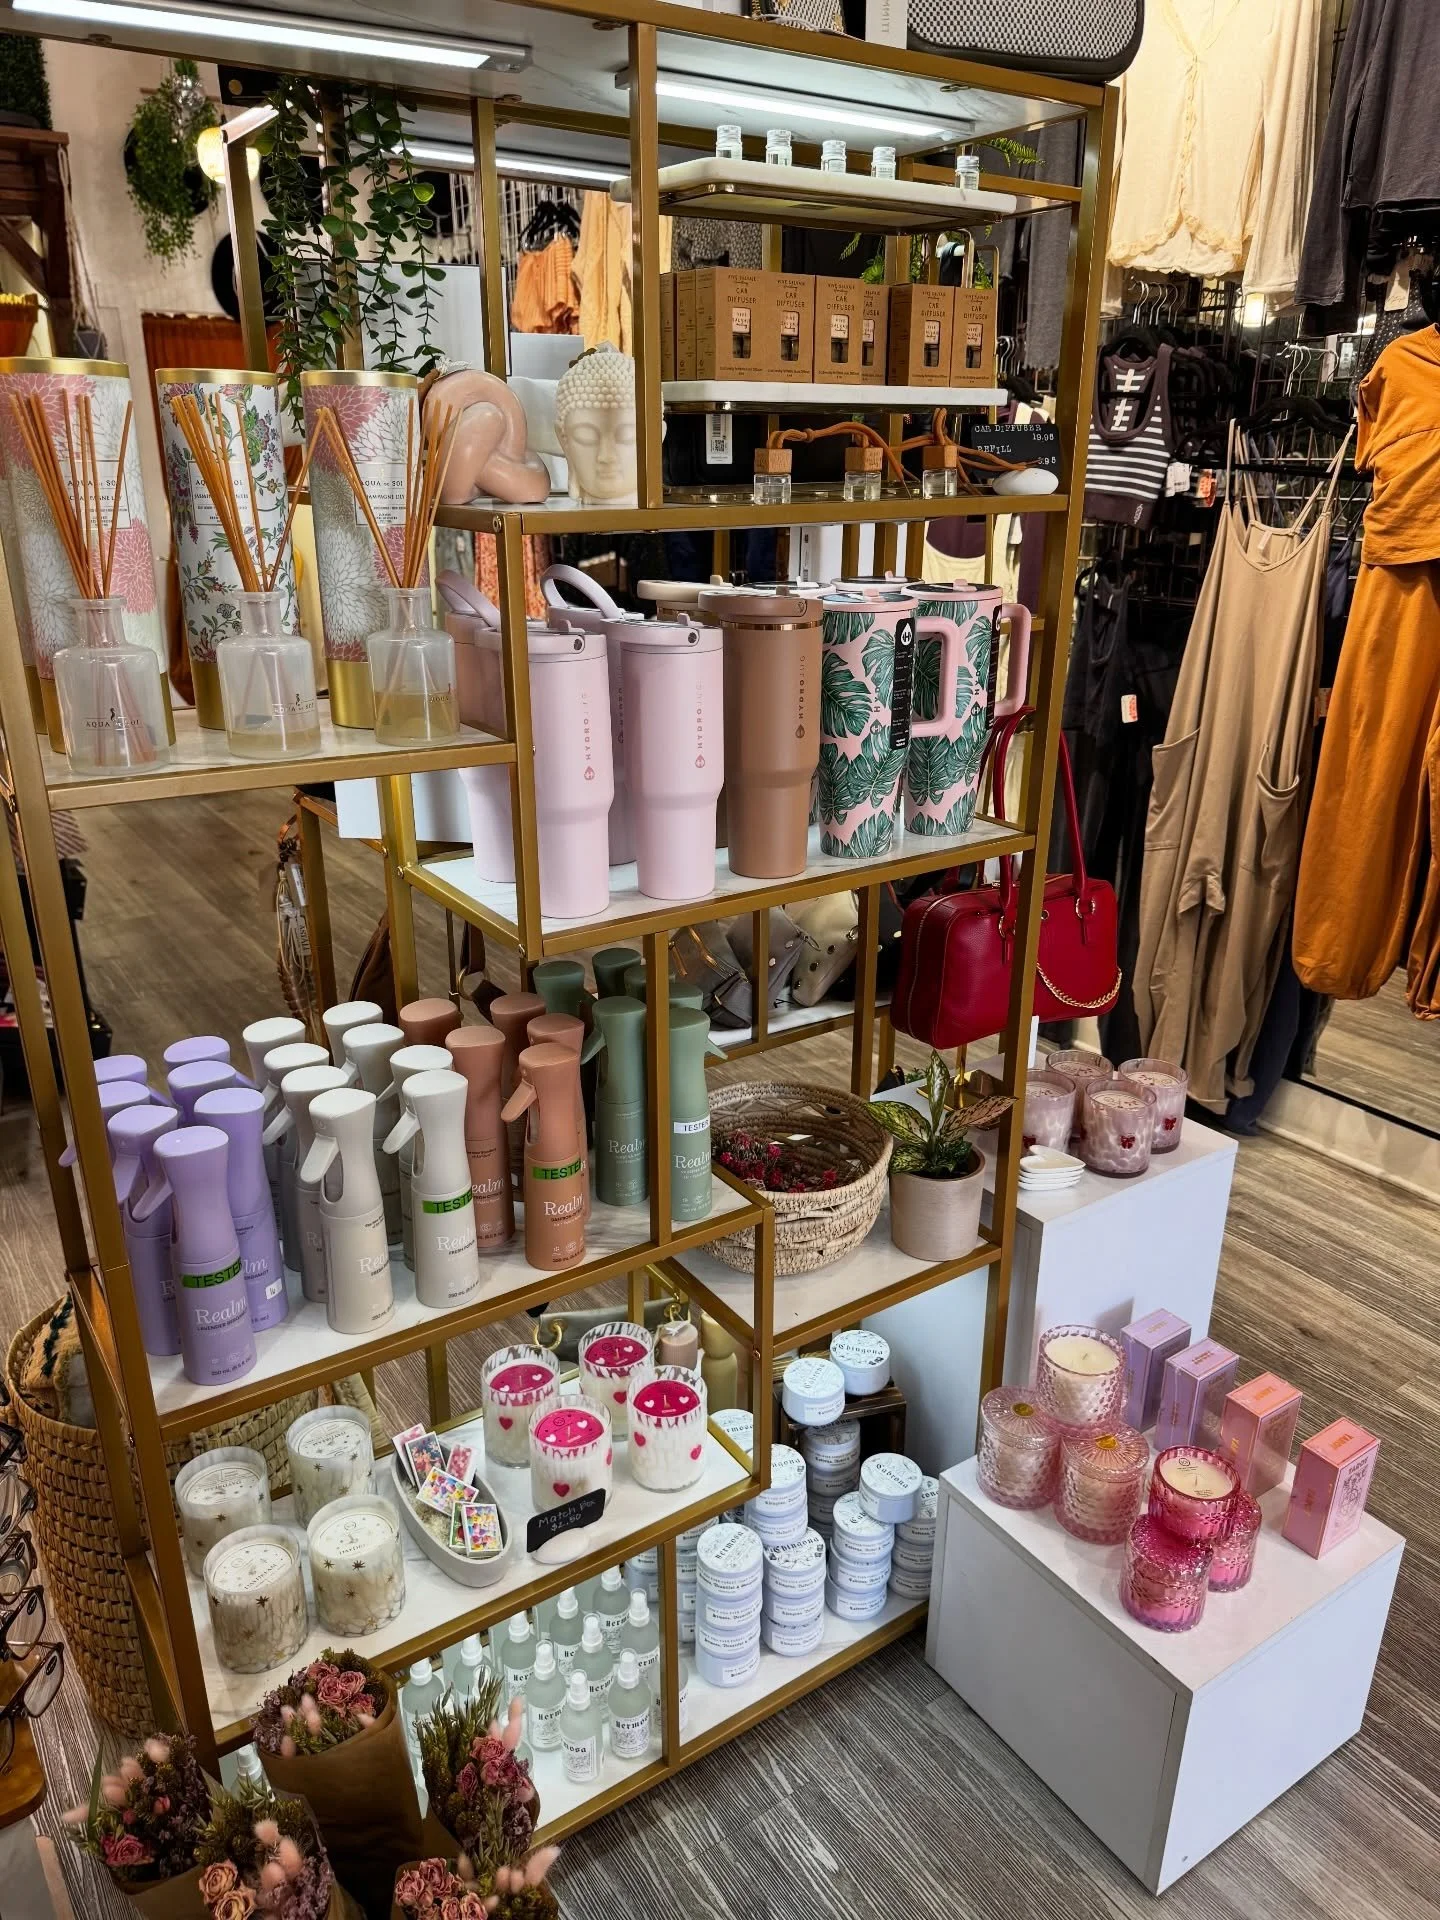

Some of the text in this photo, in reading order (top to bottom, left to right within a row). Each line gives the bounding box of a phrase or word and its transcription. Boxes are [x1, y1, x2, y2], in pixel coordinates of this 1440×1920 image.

[727, 296, 757, 304] DIFFUSER
[776, 300, 805, 308] DIFFUSER
[826, 303, 855, 311] DIFFUSER
[921, 310, 946, 318] DIFFUSER
[974, 424, 1042, 433] CAR DIFFUSER
[472, 1177, 505, 1194] ealm
[195, 1295, 248, 1325] Realm
[838, 1343, 883, 1355] Chingona
[772, 1458, 801, 1468] ngona
[876, 1463, 909, 1489] Cabrona
[538, 1505, 576, 1528] Match
[550, 1513, 582, 1532] $2.50
[714, 1531, 744, 1560] Hermosa
